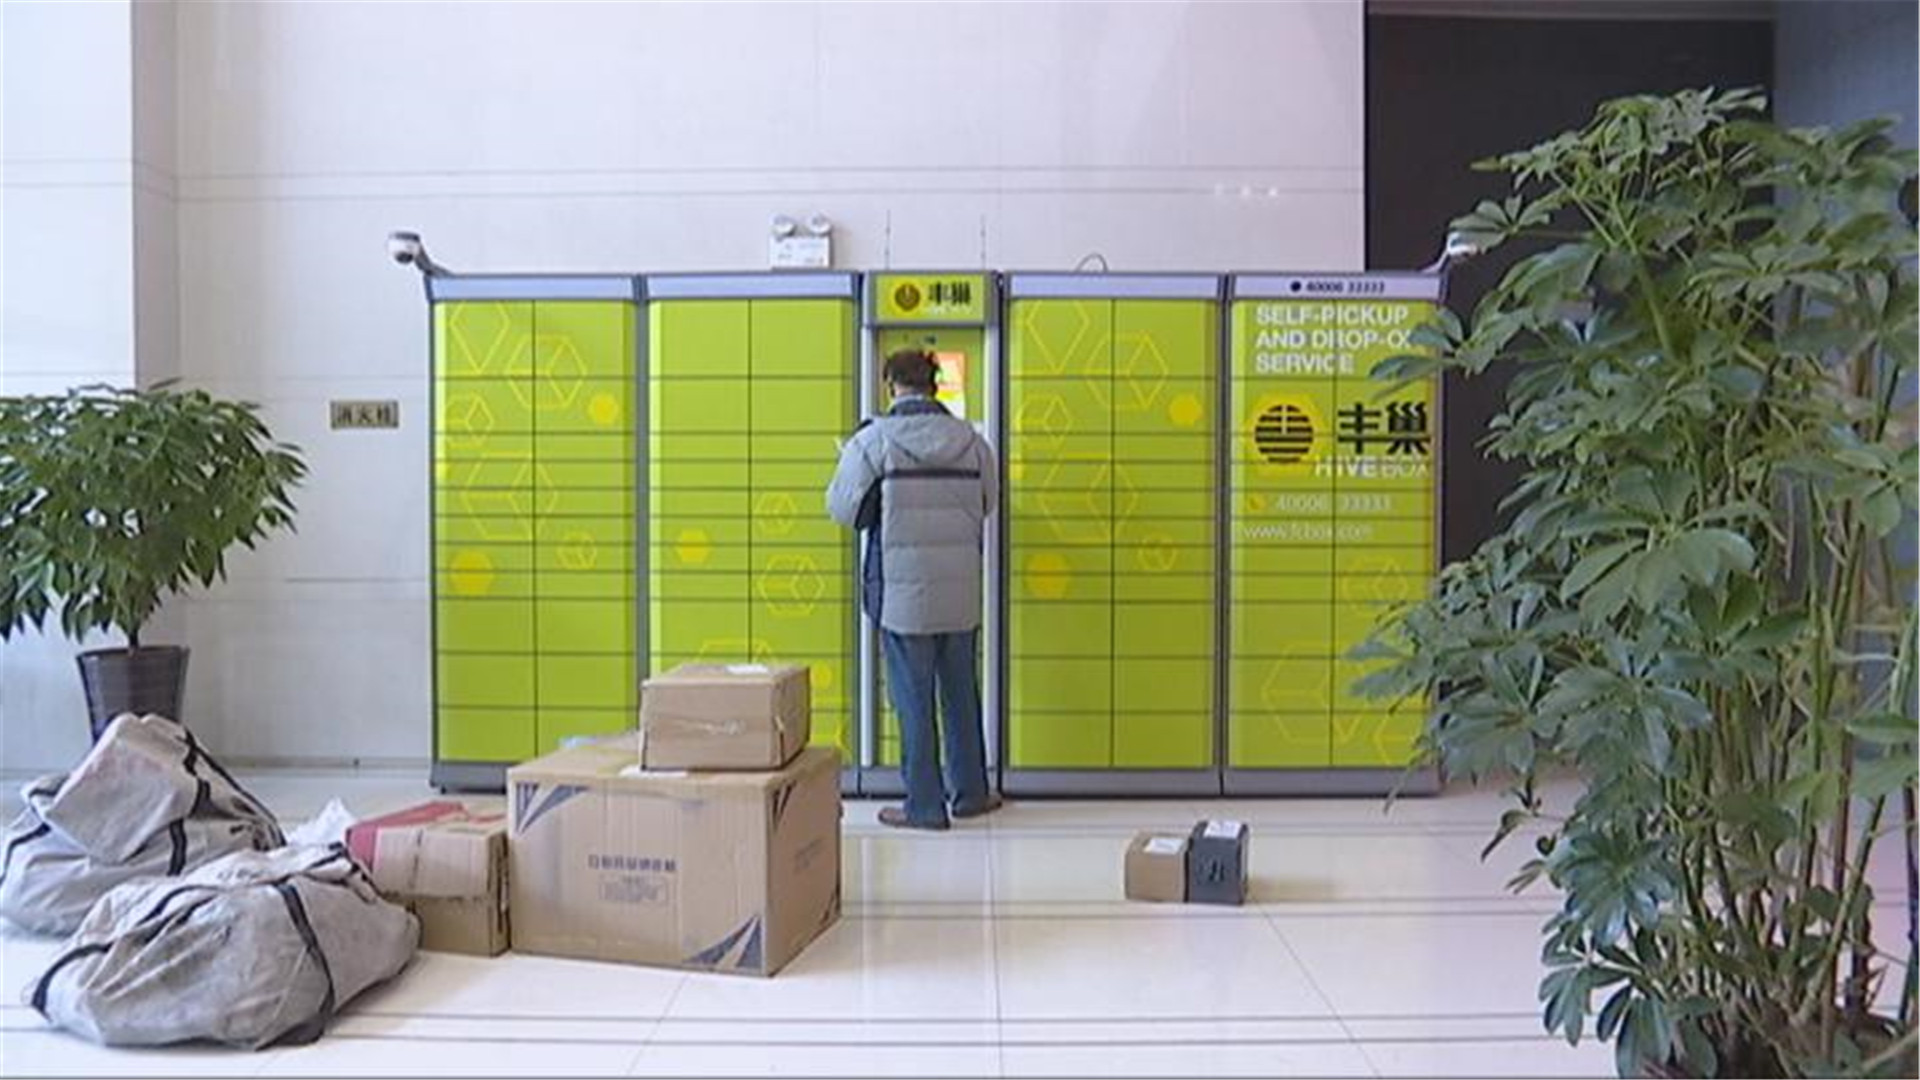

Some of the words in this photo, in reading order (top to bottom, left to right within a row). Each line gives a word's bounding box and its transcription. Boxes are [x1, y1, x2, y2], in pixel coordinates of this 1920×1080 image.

[1256, 305, 1409, 326] SELF-PICKUP
[1256, 329, 1306, 349] AND
[1256, 353, 1354, 374] SERVICE
[1337, 402, 1431, 455] 丰巢
